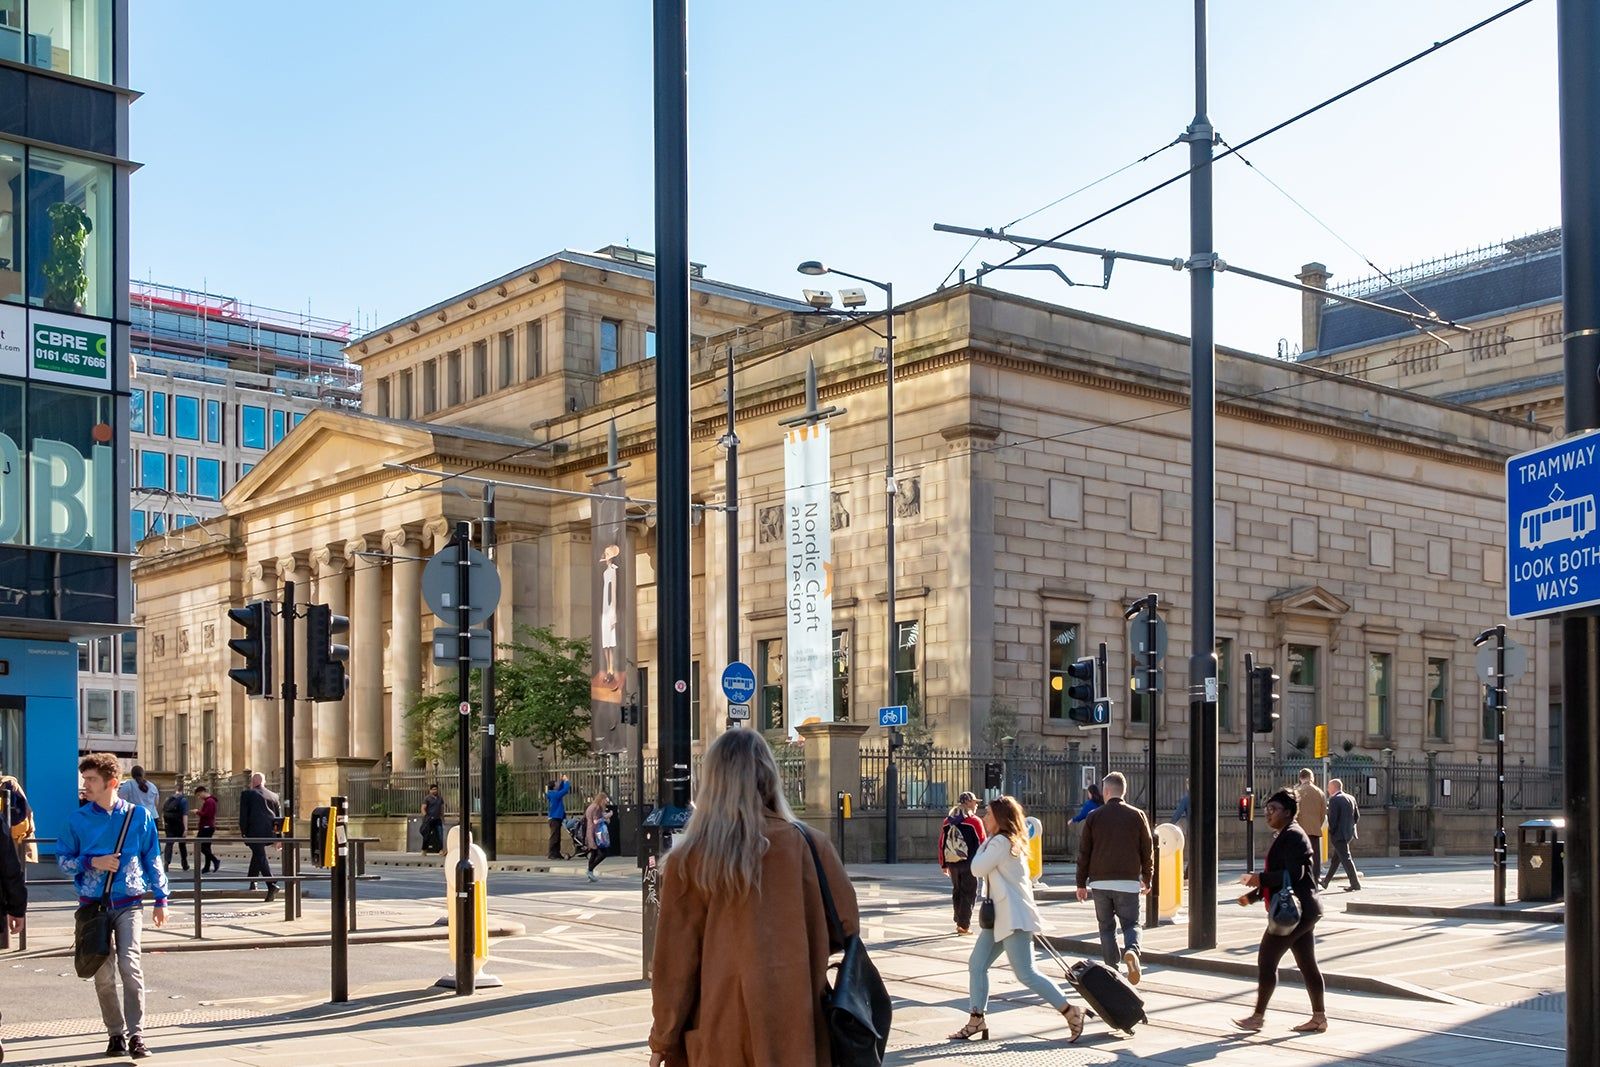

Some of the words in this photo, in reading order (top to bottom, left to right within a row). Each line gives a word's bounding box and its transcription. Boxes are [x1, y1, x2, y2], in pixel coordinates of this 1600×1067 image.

[35, 330, 88, 351] CBRE
[35, 348, 60, 361] 0161
[61, 352, 81, 365] 455
[81, 355, 106, 369] 7666
[1519, 445, 1596, 485] TRAMWAY
[791, 506, 803, 545] and
[804, 502, 820, 572] Nordic
[1514, 556, 1554, 582] LOOK
[1559, 546, 1600, 573] BOTH
[789, 554, 804, 625] Design
[805, 579, 821, 633] Craft
[1536, 576, 1580, 602] WAYS
[731, 708, 747, 716] Only
